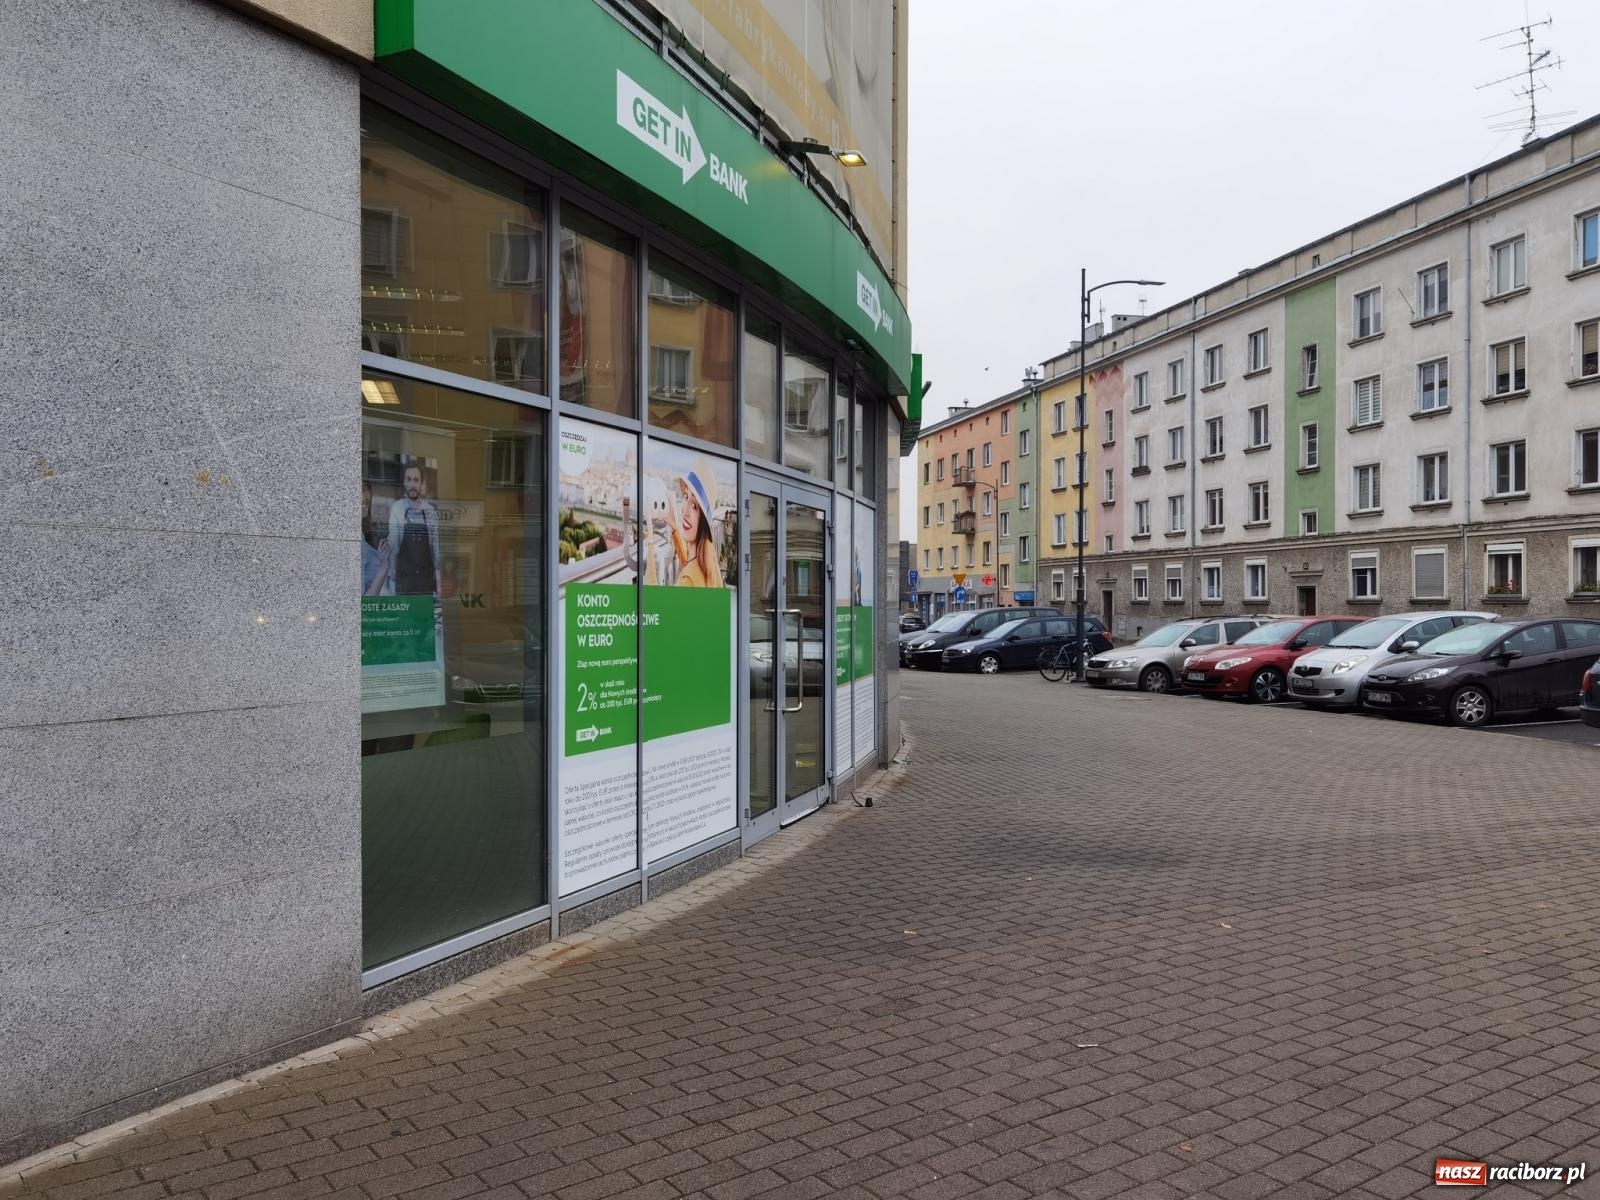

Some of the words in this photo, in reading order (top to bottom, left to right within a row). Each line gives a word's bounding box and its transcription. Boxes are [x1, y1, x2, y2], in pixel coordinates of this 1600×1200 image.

[709, 153, 749, 205] BANK
[882, 309, 894, 337] BANK
[562, 442, 569, 451] W
[569, 443, 586, 455] EURO
[577, 594, 610, 607] KONTO
[382, 603, 410, 612] ZASADY
[577, 635, 587, 647] W
[588, 633, 613, 647] EURO
[612, 657, 638, 667] perspektyw
[576, 682, 598, 712] 2%
